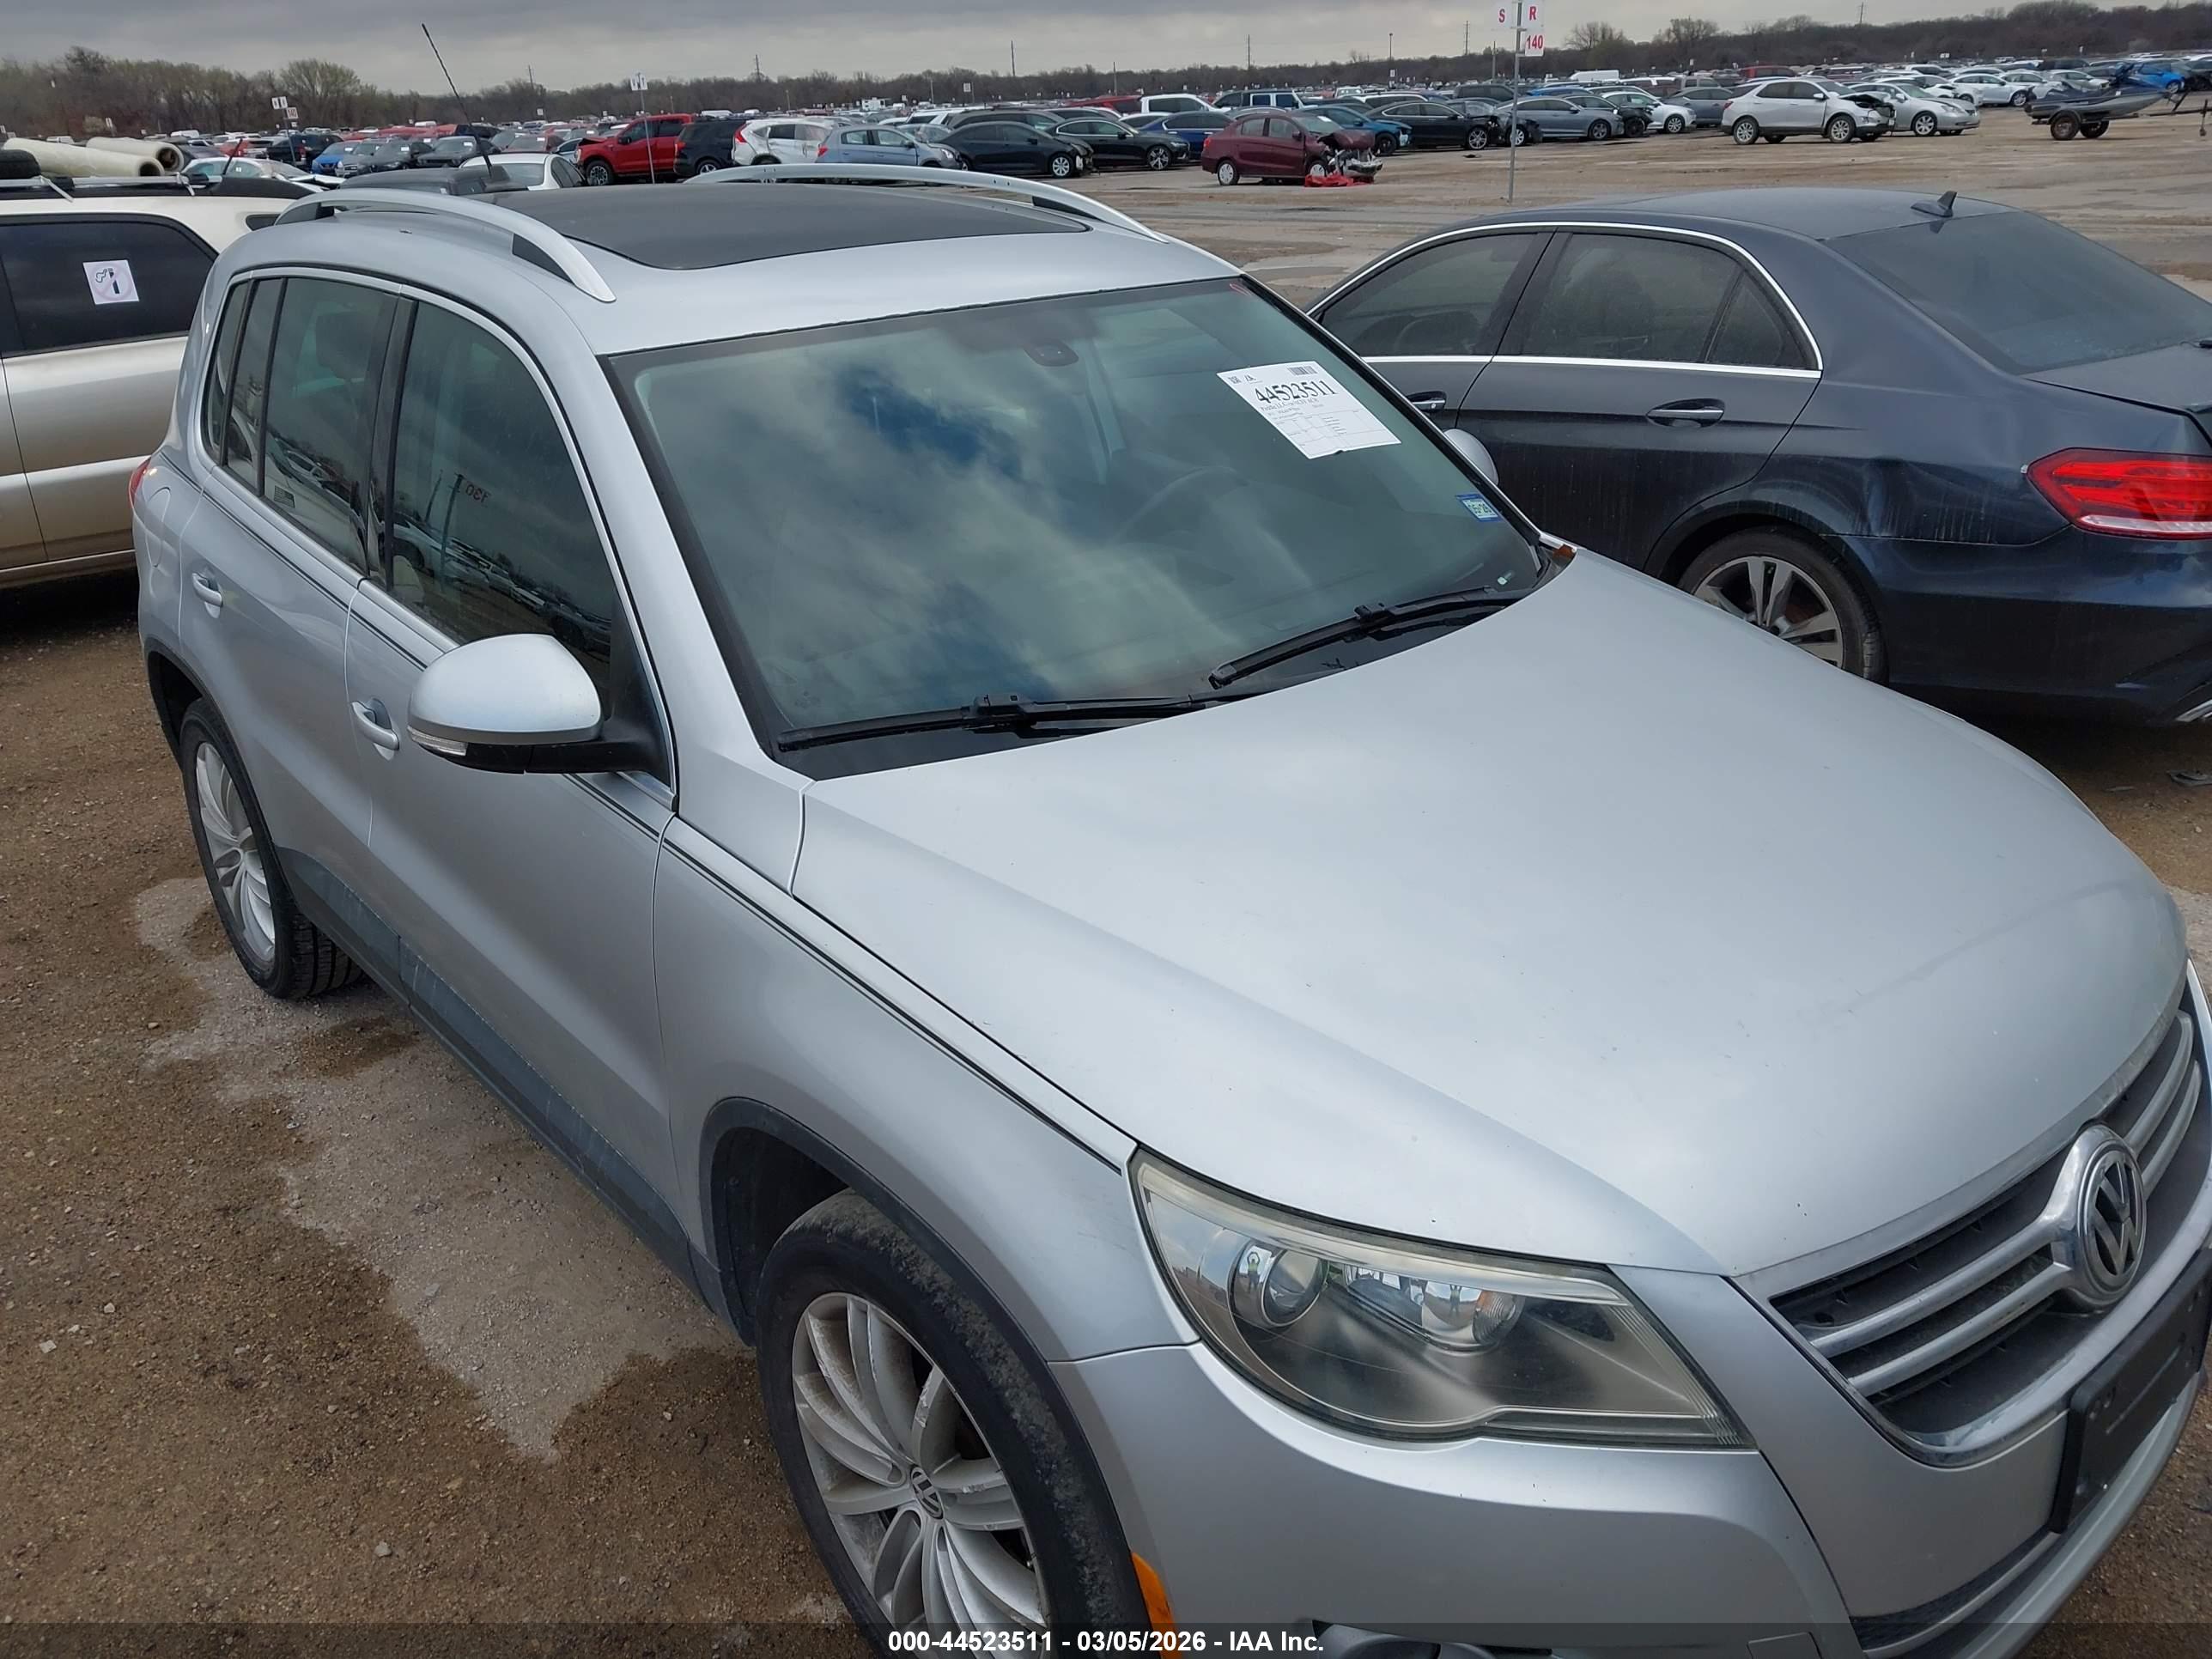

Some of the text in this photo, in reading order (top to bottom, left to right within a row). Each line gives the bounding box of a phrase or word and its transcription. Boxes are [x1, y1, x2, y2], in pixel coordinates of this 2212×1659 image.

[1498, 9, 1505, 23] S
[1529, 6, 1537, 21] R
[1526, 34, 1543, 49] 140
[1254, 380, 1338, 404] 44523511
